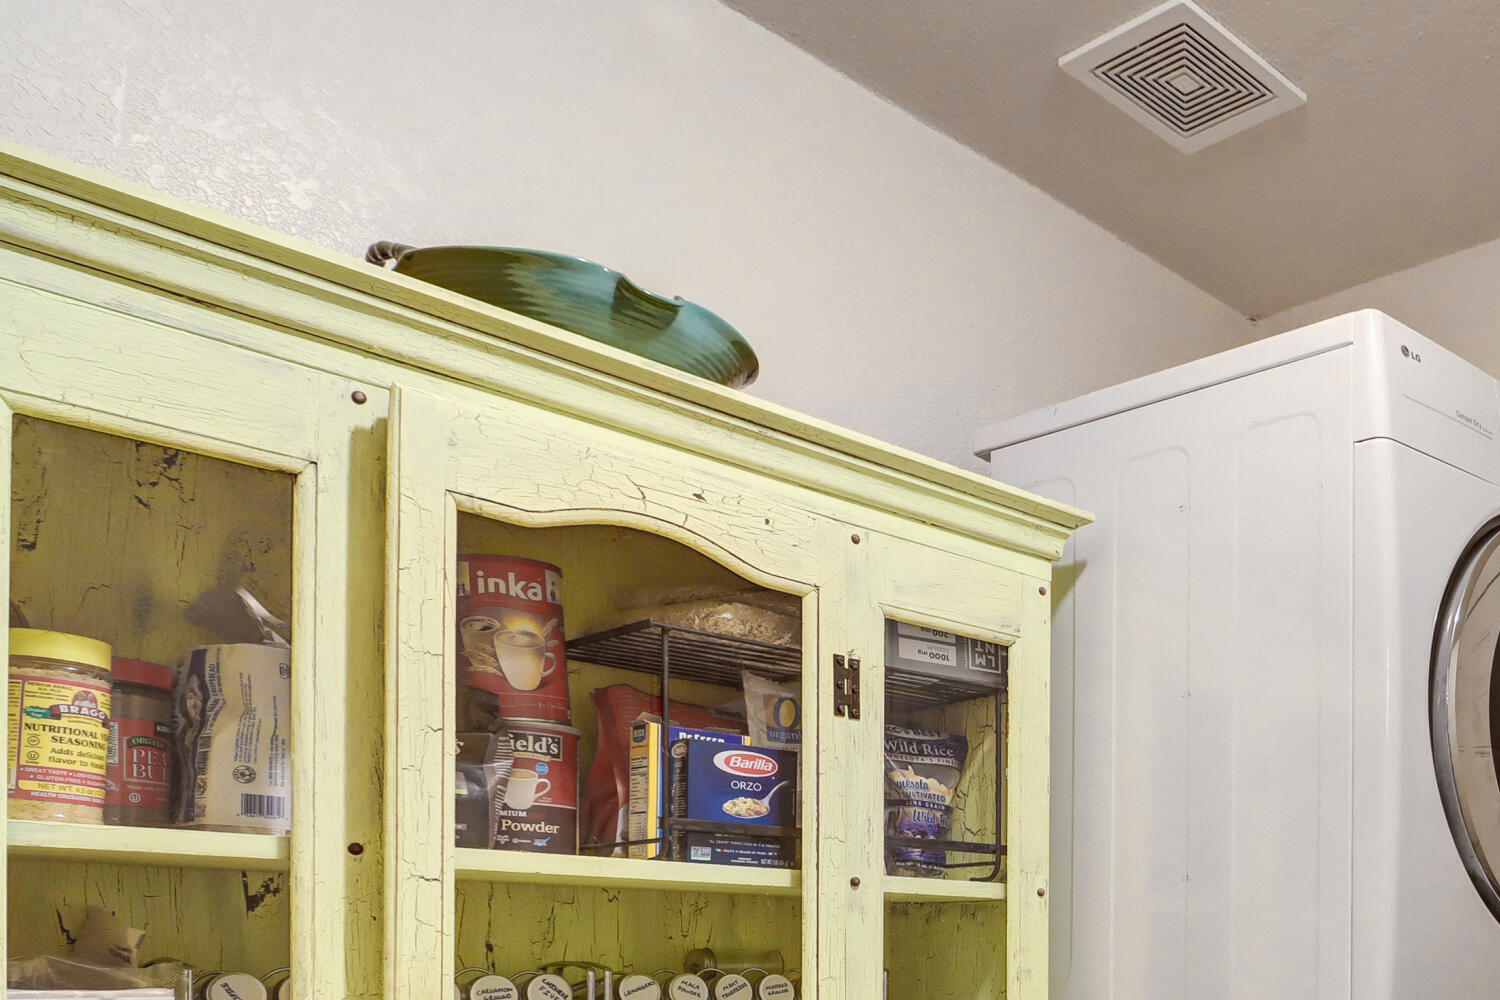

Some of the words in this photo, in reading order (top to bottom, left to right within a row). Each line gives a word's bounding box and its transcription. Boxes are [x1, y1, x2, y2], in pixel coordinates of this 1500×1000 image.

[475, 570, 543, 601] inka
[929, 651, 950, 662] 1000
[58, 704, 106, 720] BRAGG
[24, 722, 98, 740] NUTRITIONAL
[50, 735, 106, 752] SEASONING
[885, 740, 919, 754] Wild
[921, 743, 955, 757] Rice
[729, 755, 773, 773] Barilla
[730, 780, 763, 793] ORZO
[500, 818, 560, 835] Powder
